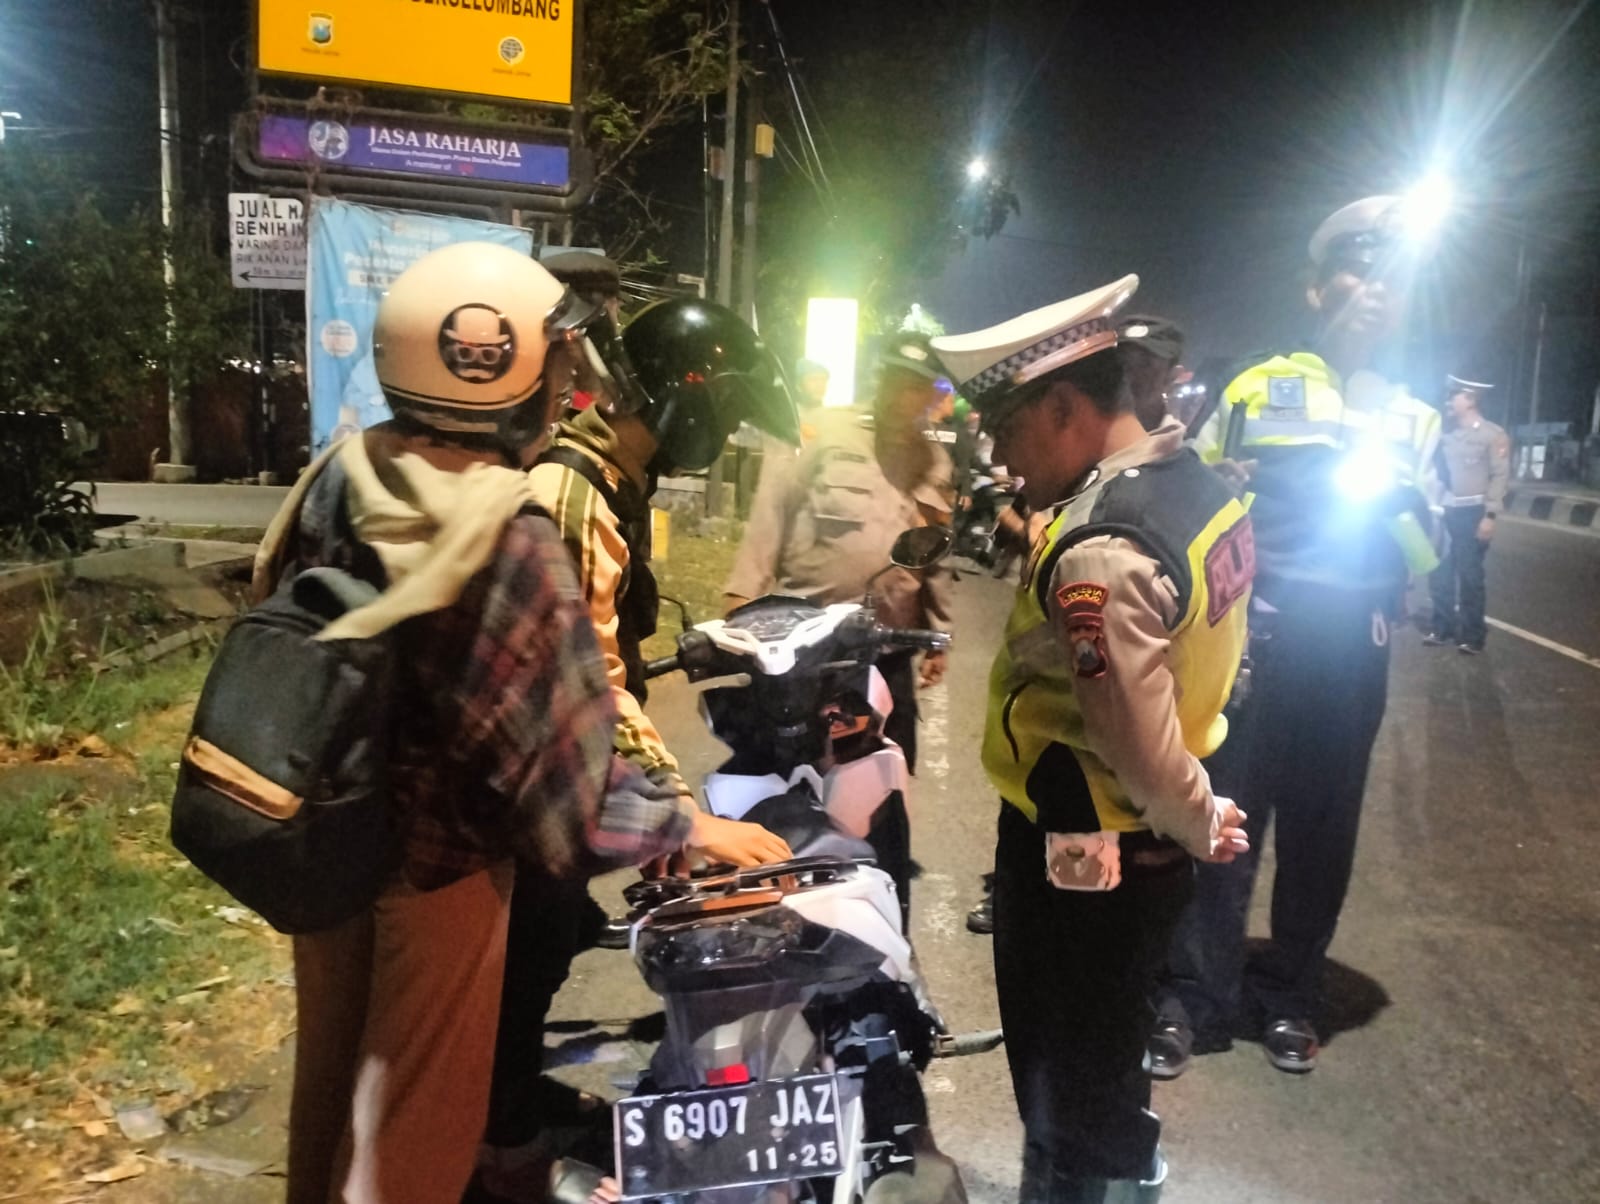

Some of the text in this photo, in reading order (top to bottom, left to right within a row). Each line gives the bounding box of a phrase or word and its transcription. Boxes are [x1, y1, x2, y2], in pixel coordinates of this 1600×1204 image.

[410, 0, 560, 21] LOMBANG
[368, 125, 420, 147] JASA
[425, 131, 521, 160] RAHARJA
[236, 200, 282, 219] JUAL
[236, 221, 287, 236] BENIH
[624, 1084, 835, 1147] S 6907 JAZ
